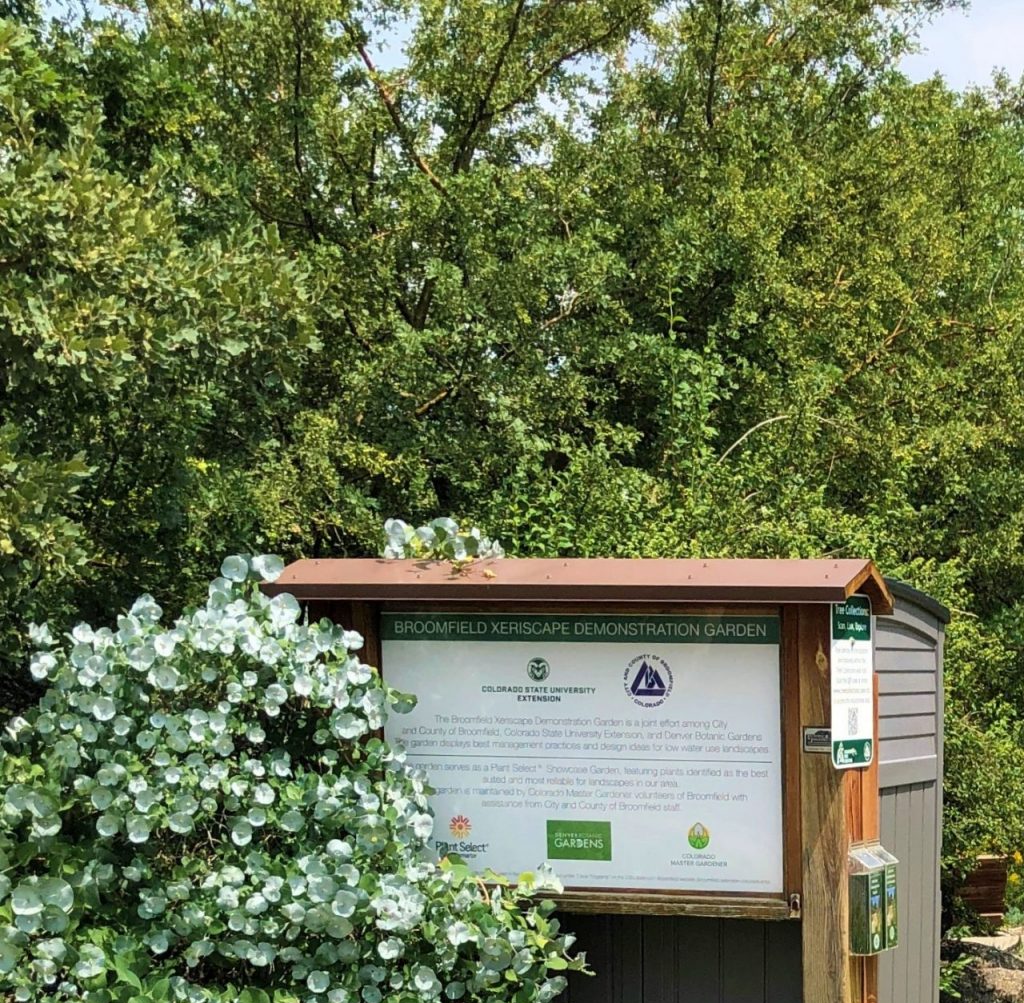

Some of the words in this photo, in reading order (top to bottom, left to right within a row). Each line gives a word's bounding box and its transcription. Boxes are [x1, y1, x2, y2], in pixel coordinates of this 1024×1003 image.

[394, 620, 488, 634] BROOMFIELD
[490, 622, 571, 635] XERISCAPE
[574, 622, 700, 636] DEMONSTRATION
[704, 623, 767, 637] GARDEN
[624, 682, 632, 697] CITY
[628, 654, 650, 668] COUNTY
[660, 660, 674, 698] BROOMFIELD
[634, 698, 664, 708] COLORADO
[434, 715, 449, 724] The
[451, 715, 493, 725] Broomfield
[494, 716, 534, 727] Xeriscape
[534, 716, 592, 726] Demonstration
[593, 717, 624, 727] Garden
[625, 718, 632, 727] is
[641, 718, 658, 729] joint
[660, 718, 680, 728] effort
[681, 720, 710, 730] among
[712, 720, 728, 730] City
[402, 726, 416, 734] and
[418, 726, 446, 736] County
[448, 727, 457, 736] of
[504, 728, 540, 737] Colorado
[542, 728, 562, 738] State
[564, 729, 602, 740] University
[647, 730, 662, 740] and
[664, 730, 692, 740] Denver
[694, 732, 726, 741] Botanic
[410, 739, 438, 749] garden
[440, 739, 472, 750] displays
[472, 740, 490, 748] best
[492, 741, 543, 751] management
[545, 742, 581, 752] practices
[583, 742, 598, 750] and
[600, 742, 628, 753] design
[629, 743, 650, 752] ideas
[652, 743, 664, 752] for
[665, 744, 680, 752] low
[681, 744, 704, 752] water
[704, 745, 720, 753] use
[444, 763, 471, 772] serves
[472, 764, 482, 772] as
[491, 763, 510, 772] Plant
[546, 764, 588, 774] Showcase
[624, 766, 658, 777] featuring
[660, 768, 684, 778] plants
[686, 768, 722, 777] identified
[722, 770, 734, 778] as
[735, 768, 748, 778] the
[750, 768, 769, 778] best
[482, 776, 507, 785] suited
[508, 776, 523, 785] and
[524, 777, 545, 786] most
[546, 777, 574, 786] reliable
[576, 778, 586, 786] for
[588, 778, 634, 788] landscapes
[636, 778, 644, 787] in
[644, 780, 658, 788] our
[436, 786, 464, 797] garden
[472, 786, 515, 796] maintained
[516, 787, 526, 798] by
[527, 788, 564, 798] Colorado
[566, 788, 594, 798] Master
[594, 789, 632, 799] Gardener
[633, 790, 675, 800] volunteers
[676, 792, 686, 800] of
[686, 791, 730, 801] Broomfield
[732, 792, 748, 802] with
[481, 800, 523, 808] assistance
[524, 800, 543, 808] from
[544, 800, 560, 810] City
[561, 800, 577, 810] and
[578, 800, 608, 812] County
[608, 801, 618, 810] of
[618, 802, 661, 812] Broomfield
[436, 841, 458, 852] Plnt
[554, 838, 604, 849] GARDENS
